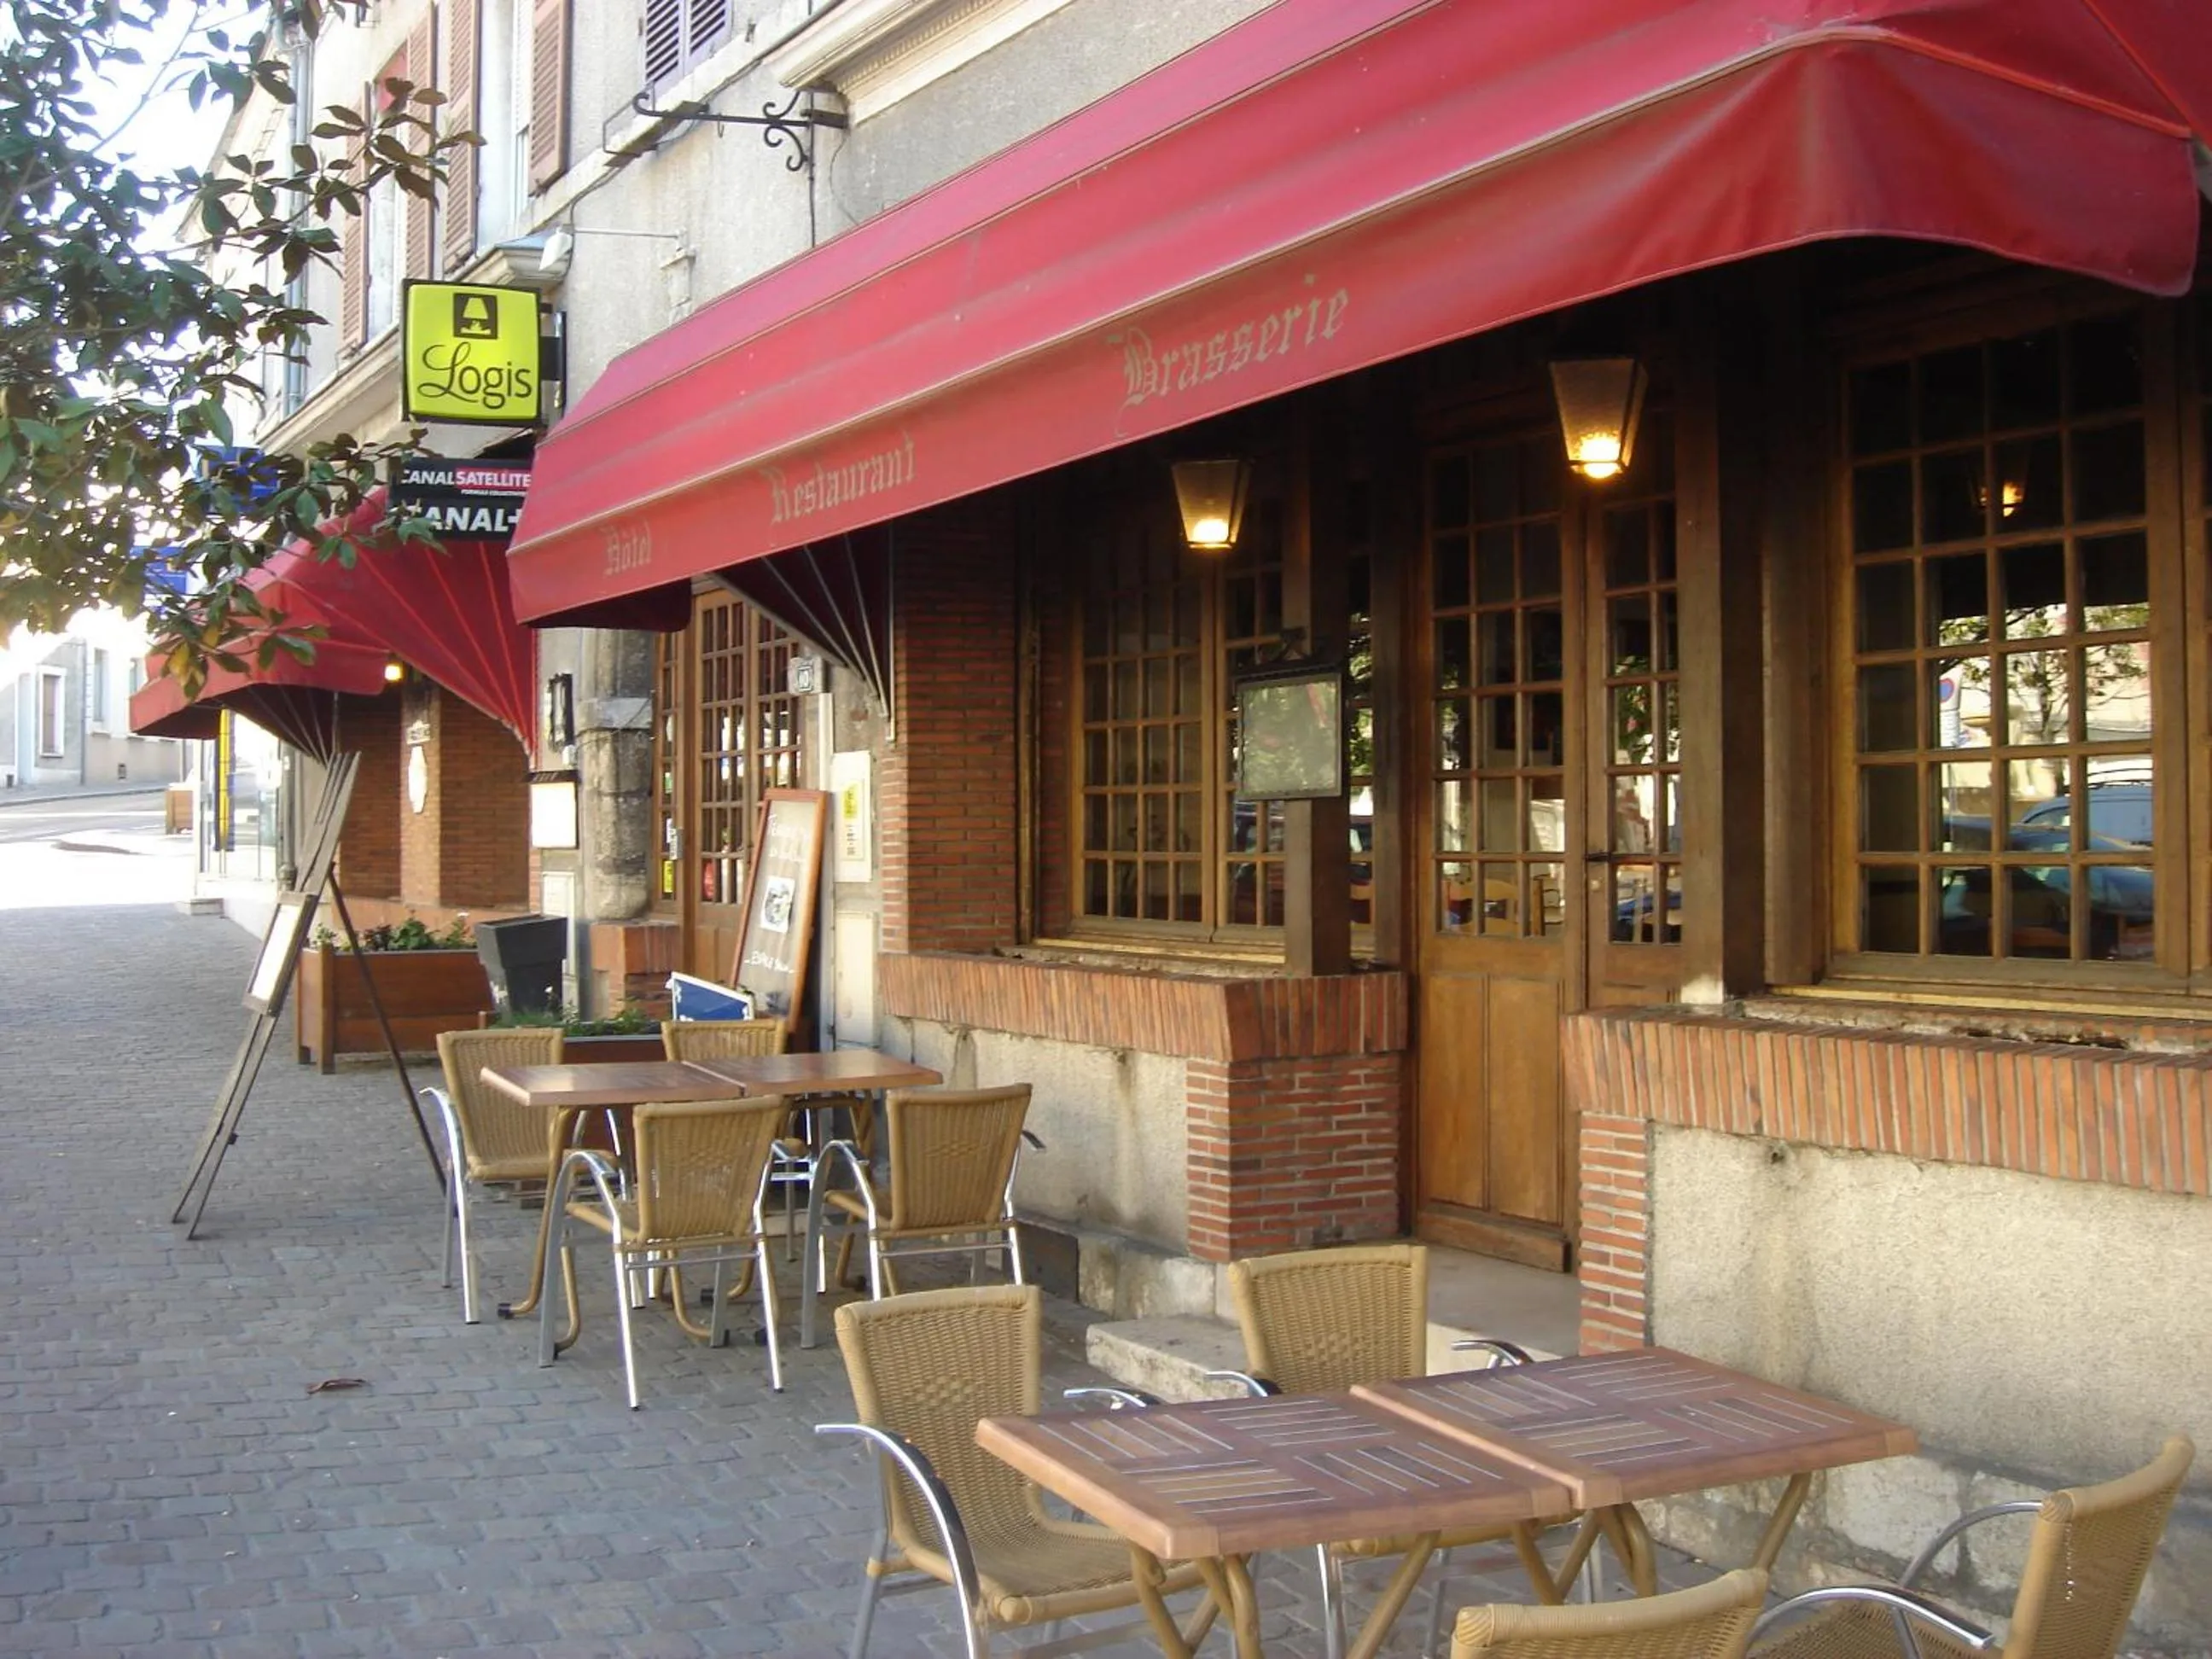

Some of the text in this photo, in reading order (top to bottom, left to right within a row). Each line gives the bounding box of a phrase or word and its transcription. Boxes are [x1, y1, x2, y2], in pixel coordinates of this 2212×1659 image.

[417, 341, 532, 409] Logis
[760, 431, 917, 524] Restaurant
[1111, 273, 1348, 437] Brasserie
